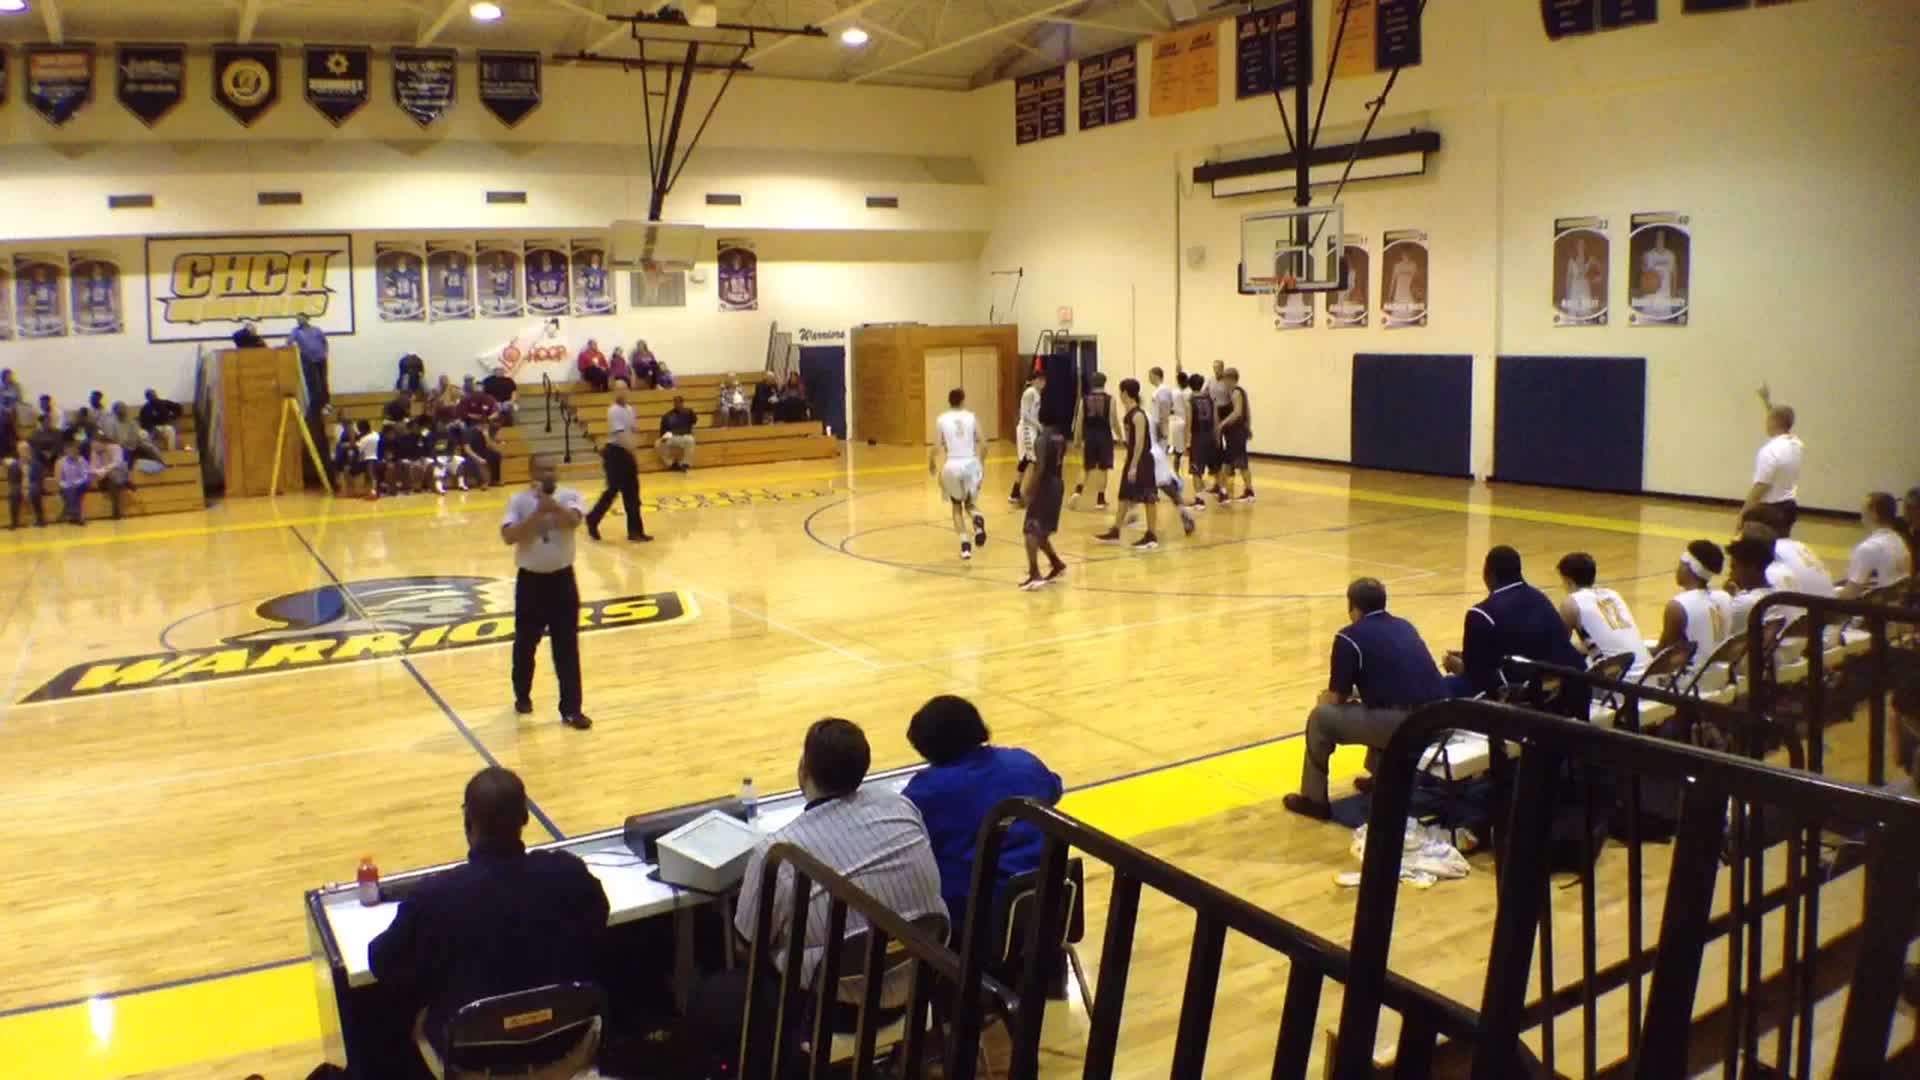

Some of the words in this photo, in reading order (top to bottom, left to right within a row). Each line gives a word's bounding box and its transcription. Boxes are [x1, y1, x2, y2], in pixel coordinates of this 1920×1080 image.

[172, 251, 338, 297] CHCA
[799, 328, 846, 342] Warriors
[71, 598, 660, 693] WARRIOS
